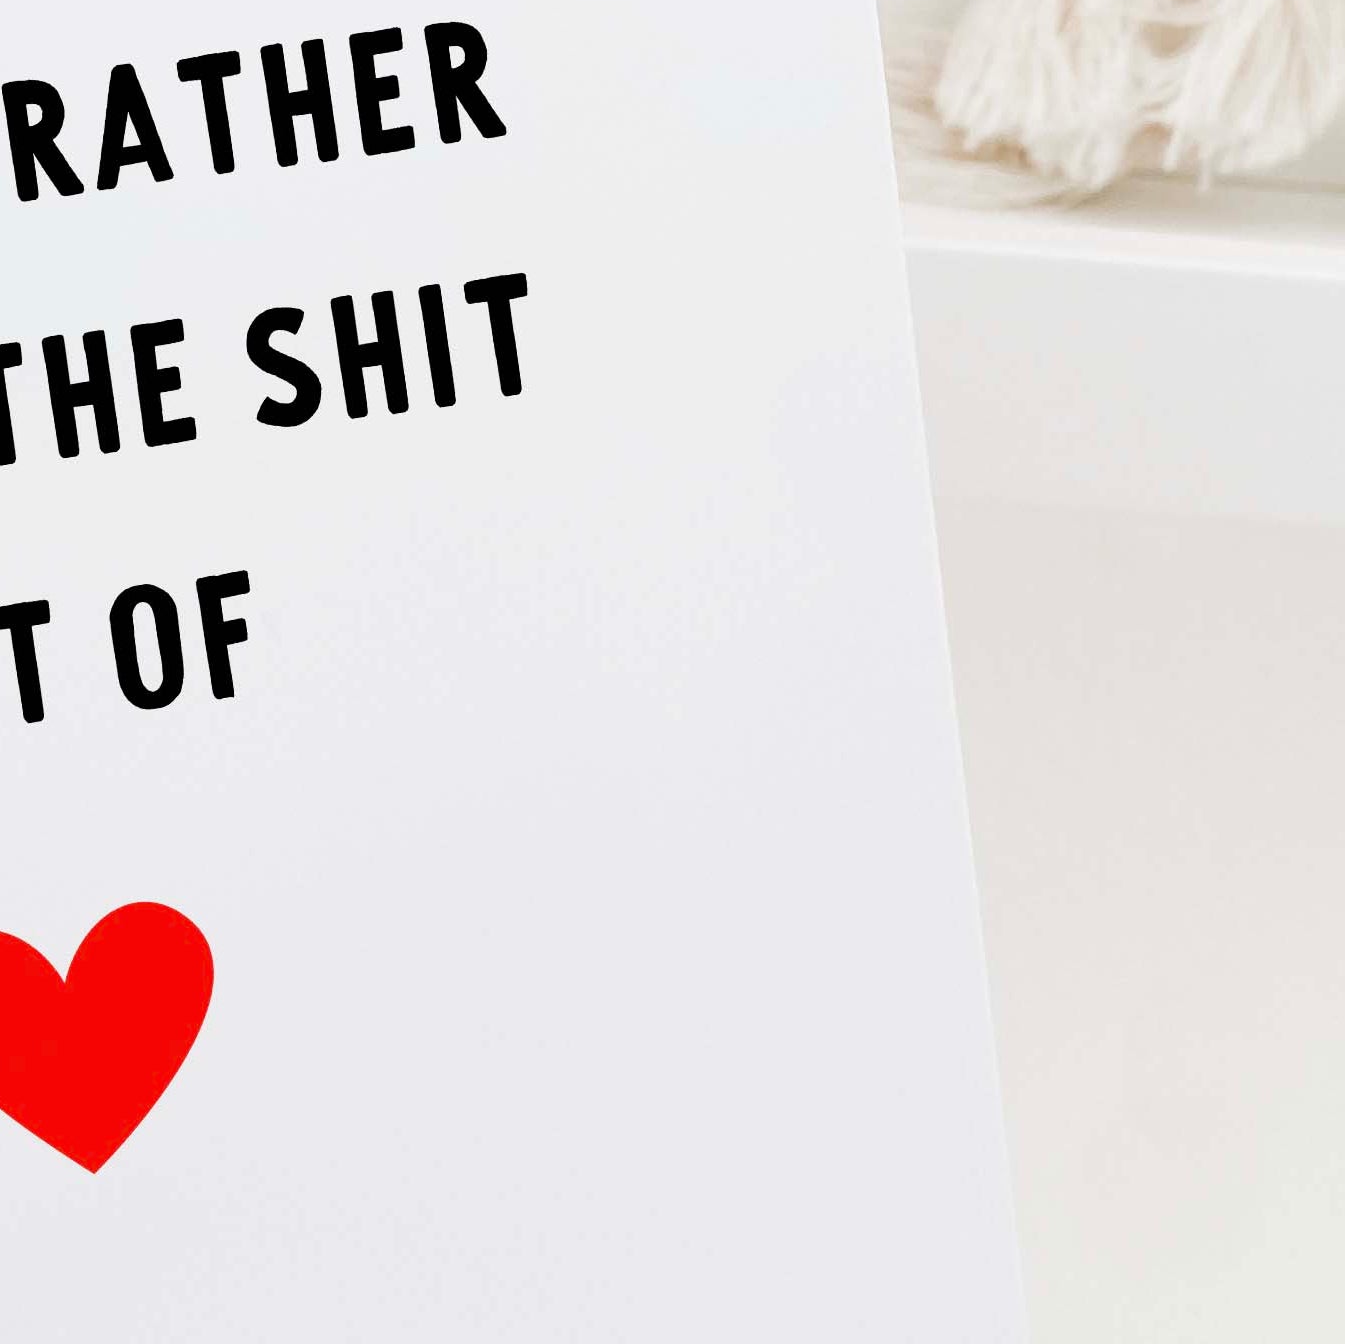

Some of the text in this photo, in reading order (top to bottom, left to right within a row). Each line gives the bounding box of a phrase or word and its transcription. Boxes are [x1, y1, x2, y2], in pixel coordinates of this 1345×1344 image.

[2, 22, 506, 201] RATHER
[247, 273, 527, 427] SHIT
[110, 570, 250, 709] OF
